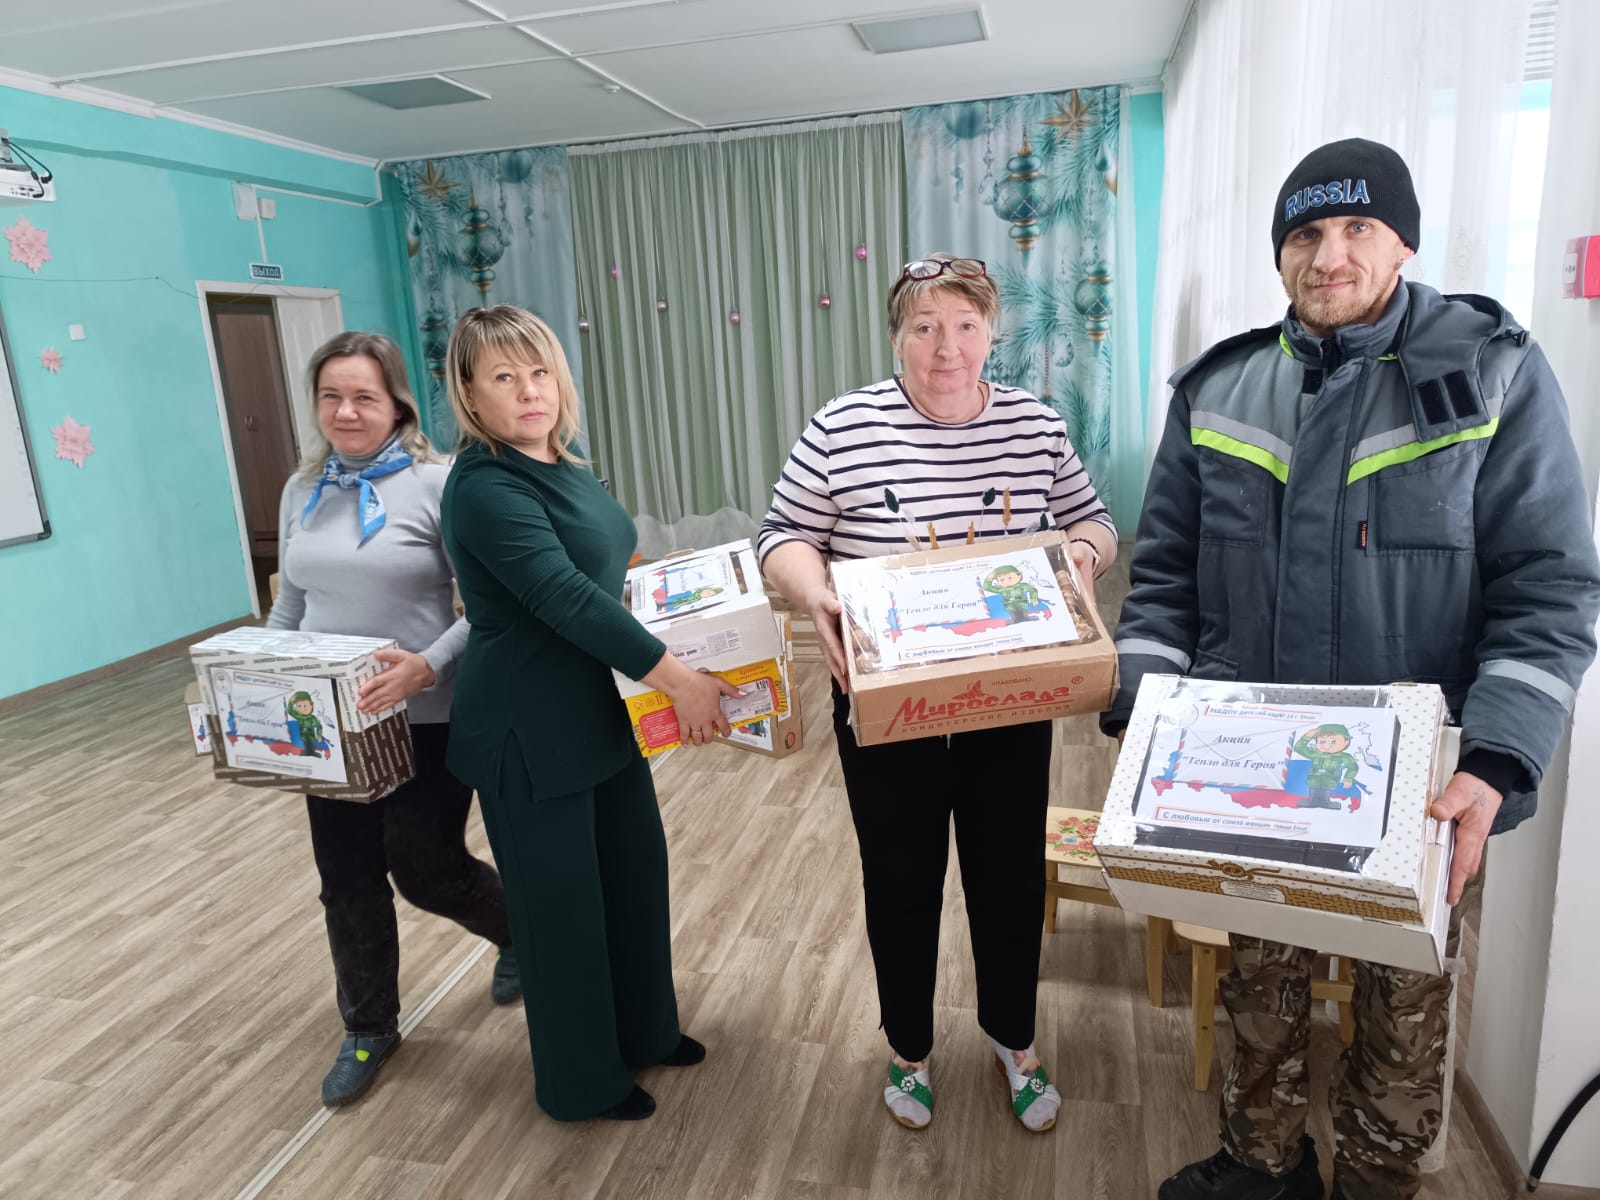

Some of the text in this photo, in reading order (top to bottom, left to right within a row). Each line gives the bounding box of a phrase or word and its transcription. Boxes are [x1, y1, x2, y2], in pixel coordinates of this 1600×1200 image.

[1285, 179, 1370, 222] RUSSIA
[252, 266, 281, 278] ВЫХОД
[921, 587, 949, 597] Акция
[902, 713, 1001, 733] КОНДИТЕРСКИЕ
[1213, 734, 1251, 745] Акция
[1221, 759, 1240, 768] для
[1163, 811, 1169, 819] С
[1171, 813, 1210, 823] любовью
